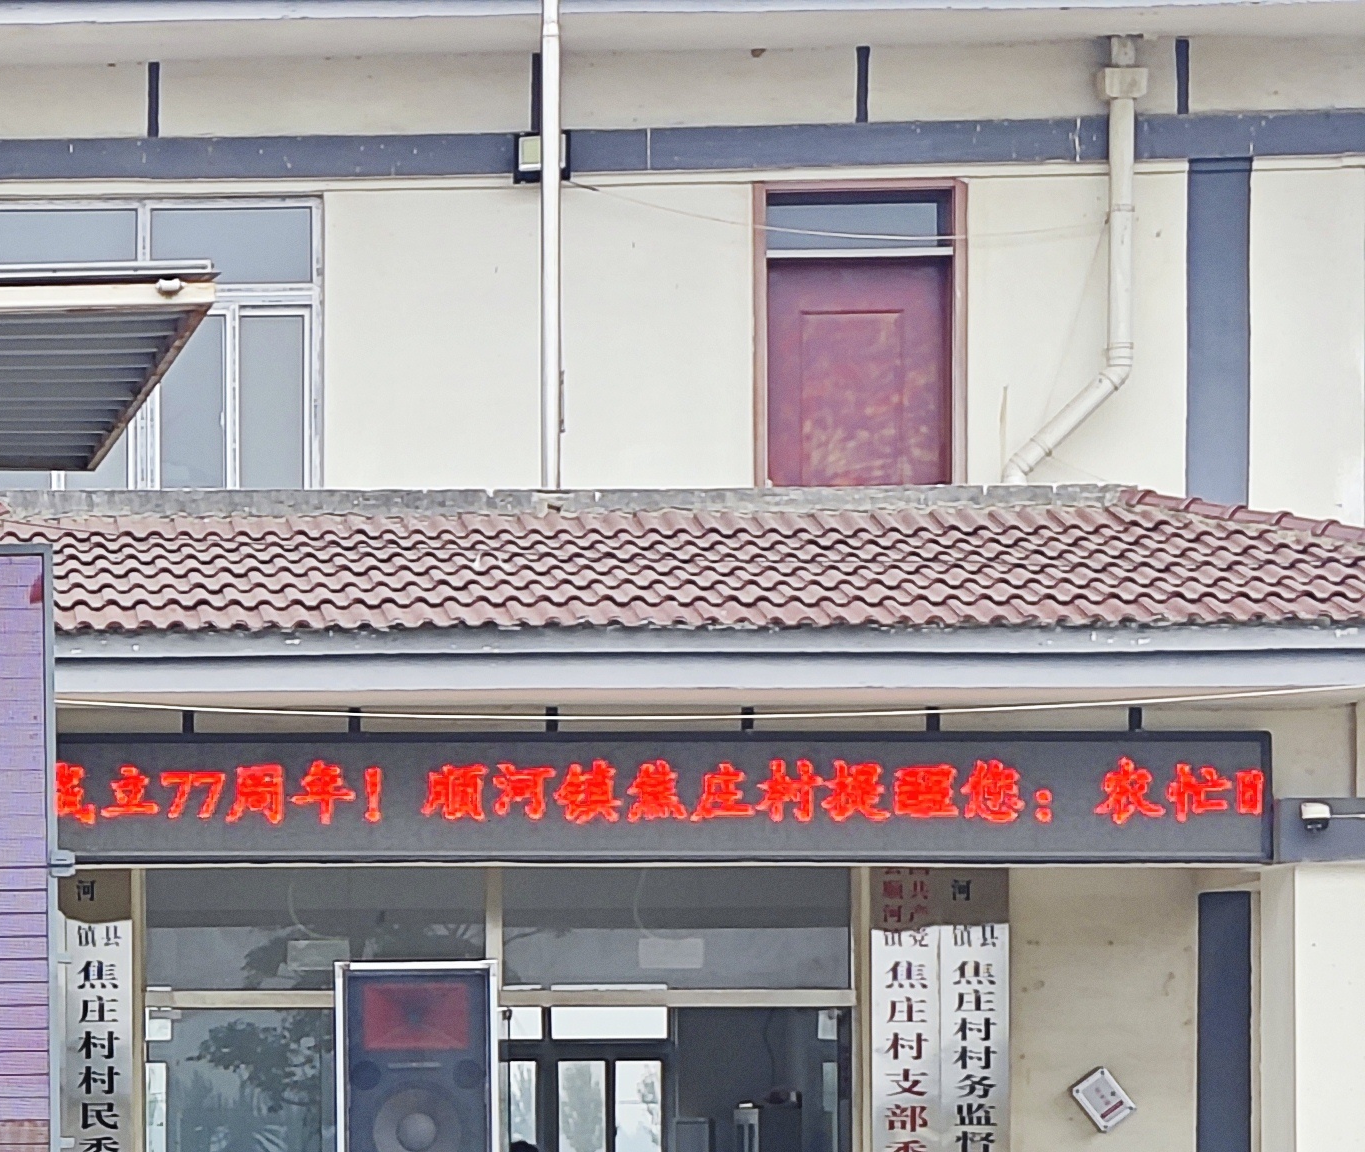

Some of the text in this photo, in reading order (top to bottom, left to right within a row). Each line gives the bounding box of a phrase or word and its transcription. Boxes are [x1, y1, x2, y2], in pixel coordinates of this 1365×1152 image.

[883, 868, 903, 947] 顺河镇
[908, 868, 930, 947] 共产党
